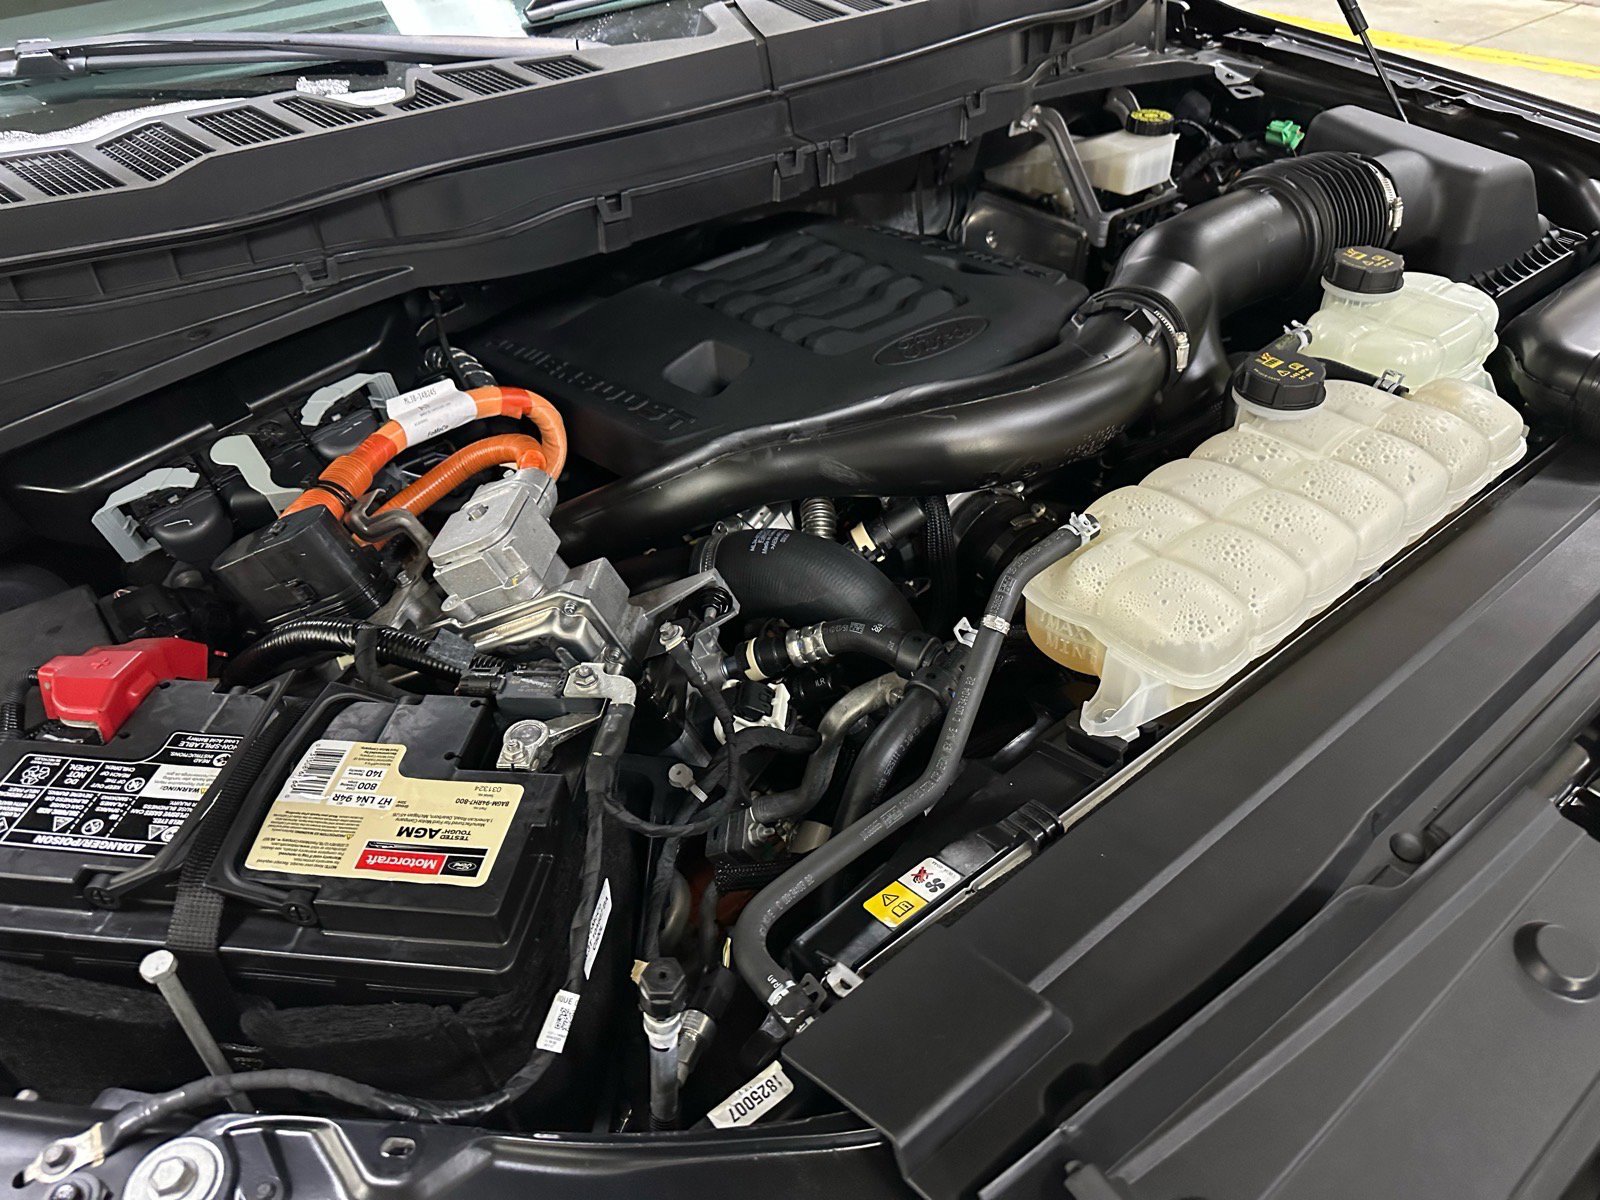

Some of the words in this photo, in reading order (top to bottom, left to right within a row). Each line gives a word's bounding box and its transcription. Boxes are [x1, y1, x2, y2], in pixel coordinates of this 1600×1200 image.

[1046, 631, 1087, 660] MIN
[160, 785, 200, 793] WARNING:
[356, 782, 378, 790] 800
[331, 793, 354, 802] 94R
[354, 795, 376, 803] LN4
[395, 825, 442, 839] AGM
[33, 834, 134, 851] DANGER/POISON
[364, 853, 438, 869] Motorcraft
[728, 1075, 783, 1123] 1825007
